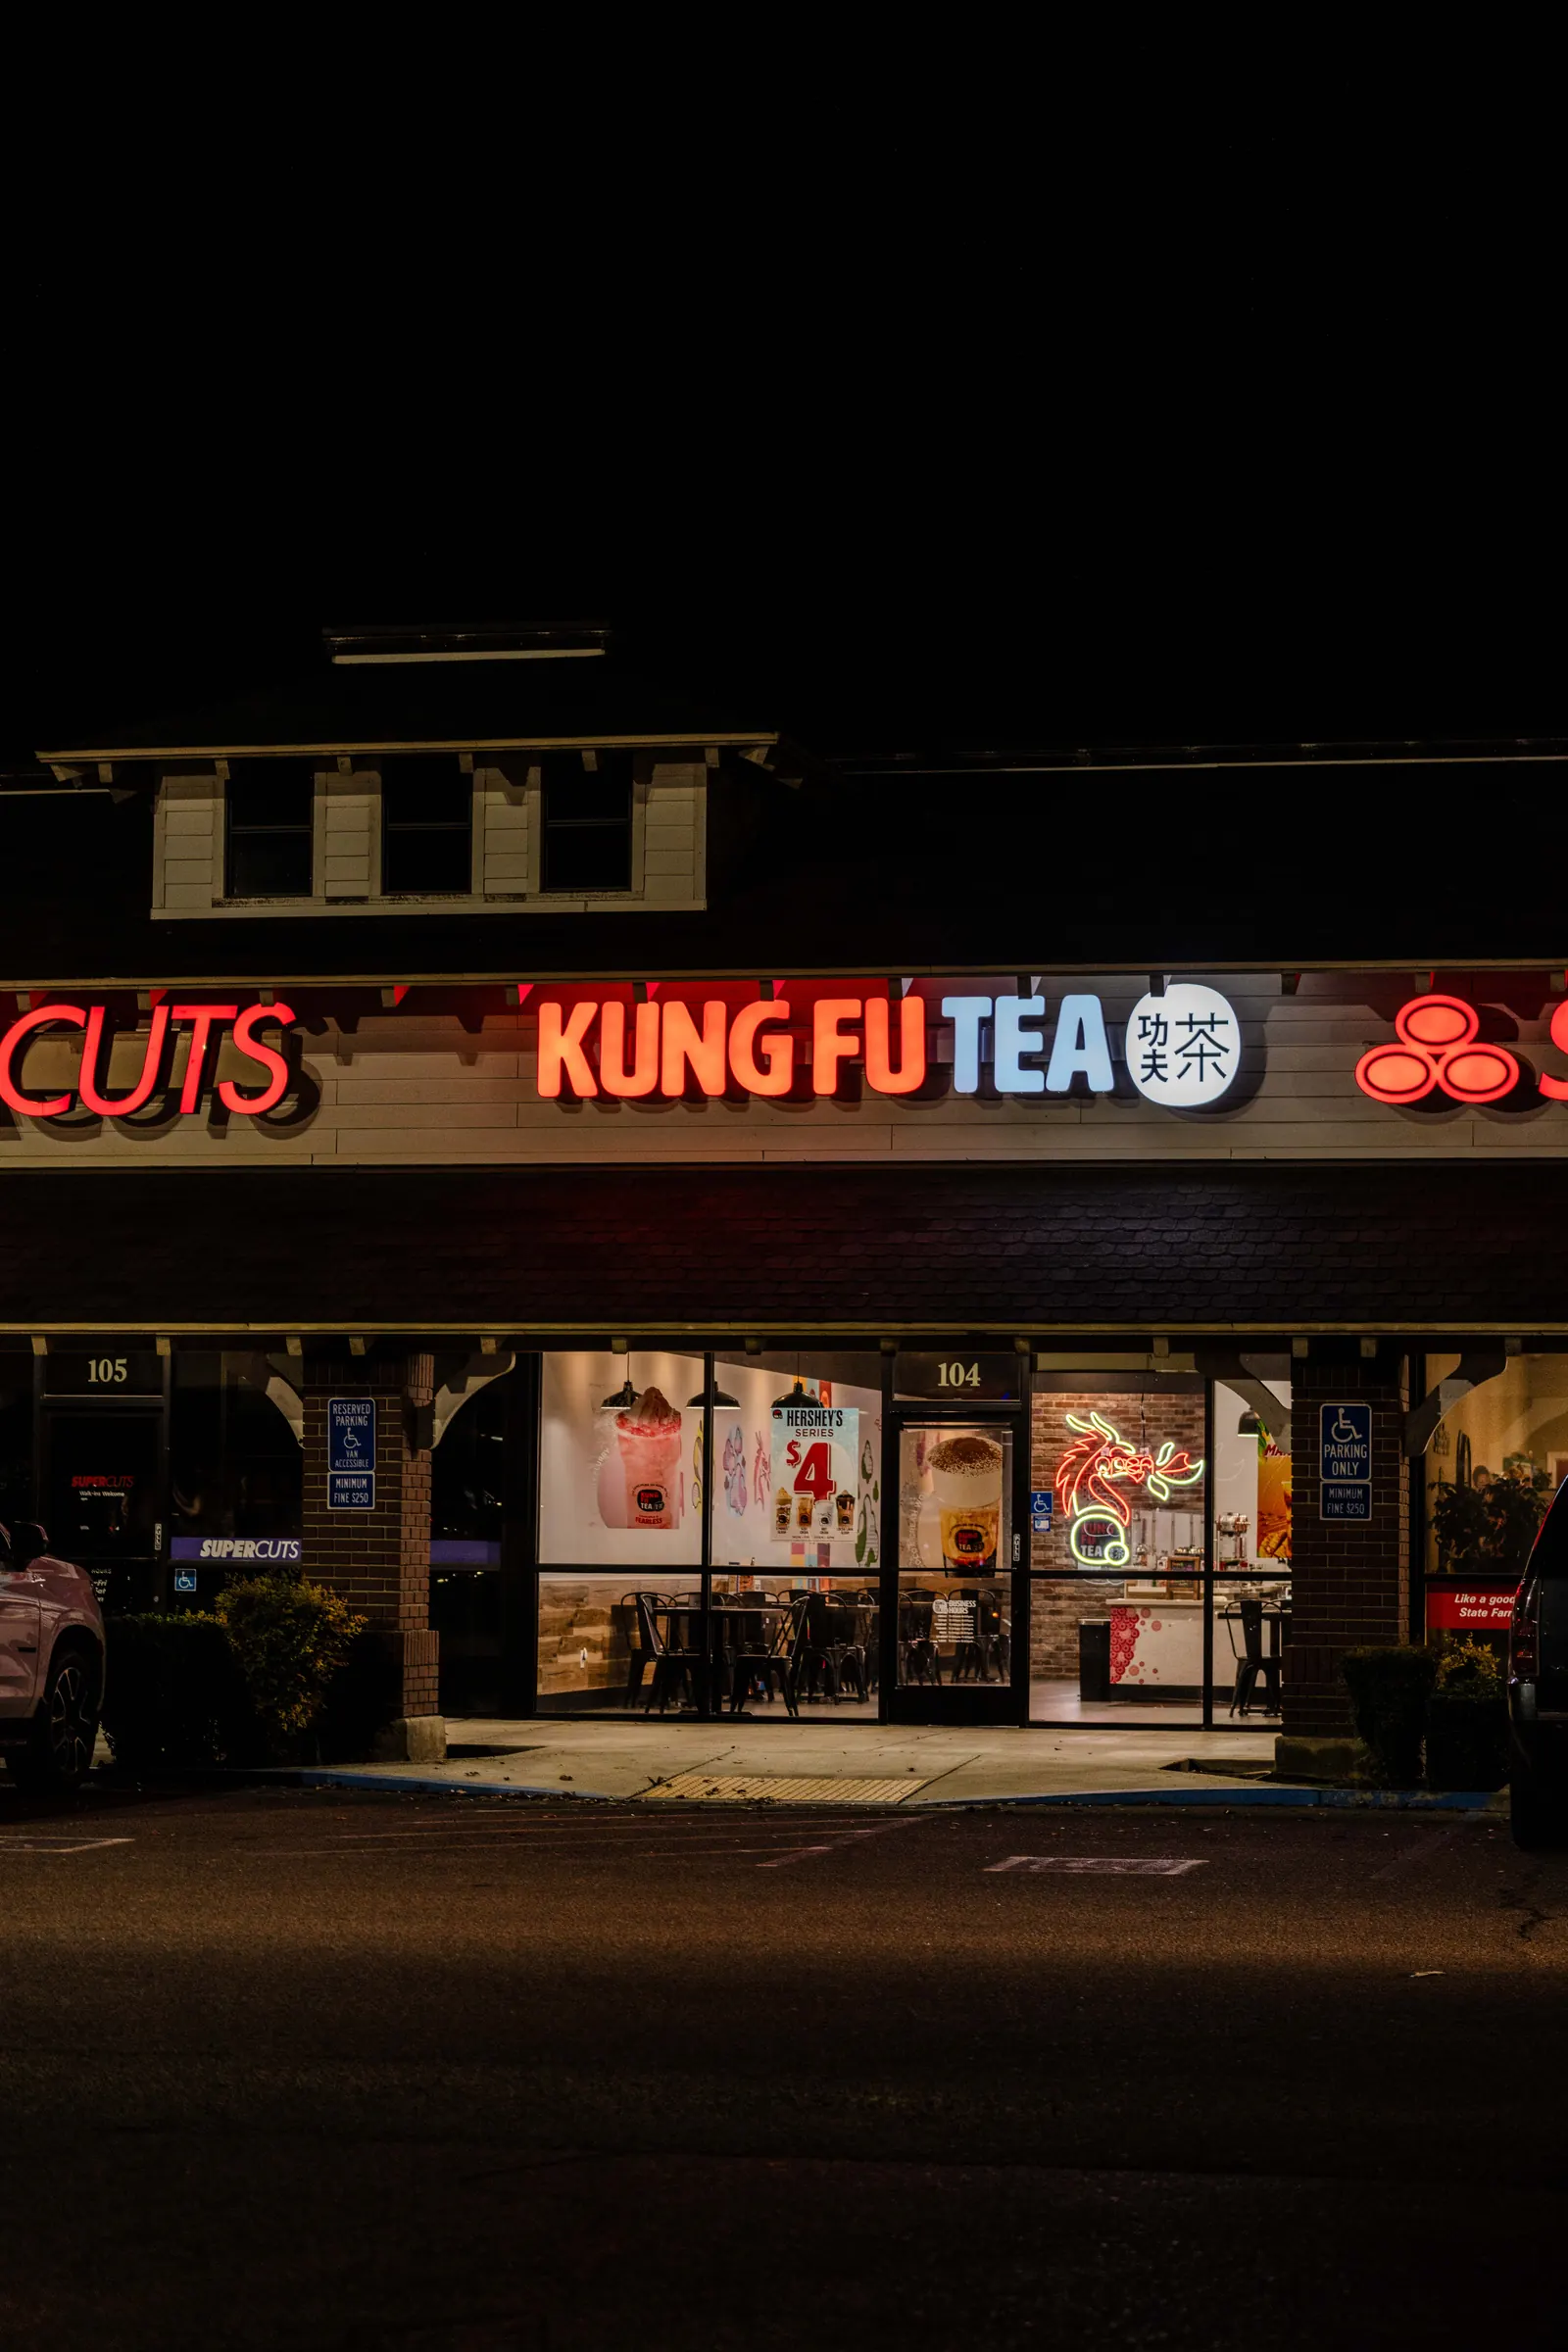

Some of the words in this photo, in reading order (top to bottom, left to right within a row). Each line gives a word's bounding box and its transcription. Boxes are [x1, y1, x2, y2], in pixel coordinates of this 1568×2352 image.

[537, 1000, 792, 1099] KUNG
[812, 996, 925, 1095] FU
[941, 994, 1114, 1094] TEA
[1138, 1012, 1170, 1084] 功夫
[1174, 1011, 1231, 1084] 茶
[0, 1003, 296, 1117] CUTS
[87, 1358, 127, 1383] 105
[937, 1362, 982, 1387] 104
[332, 1403, 371, 1415] RESERVED
[335, 1415, 368, 1427] PARKING
[786, 1409, 844, 1427] HERSHEY'S
[795, 1428, 834, 1438] SERIES
[346, 1449, 359, 1459] VAN
[1324, 1444, 1368, 1459] PARKING
[334, 1458, 369, 1468] ACCESSIBLE
[1331, 1461, 1360, 1476] ONLY
[786, 1440, 837, 1501] $4
[71, 1475, 136, 1489] SUPERCUTS
[335, 1478, 368, 1489] MINIMUM
[333, 1493, 350, 1503] FINE
[351, 1493, 368, 1503] $250
[1328, 1488, 1363, 1499] MINIMUM
[1327, 1503, 1345, 1514] FINE
[1346, 1502, 1365, 1514] $250
[200, 1539, 300, 1559] SUPERCUTS
[1080, 1544, 1102, 1557] TEA
[949, 1599, 977, 1608] BUSINESS
[1454, 1593, 1477, 1604] Like
[1459, 1607, 1489, 1618] State
